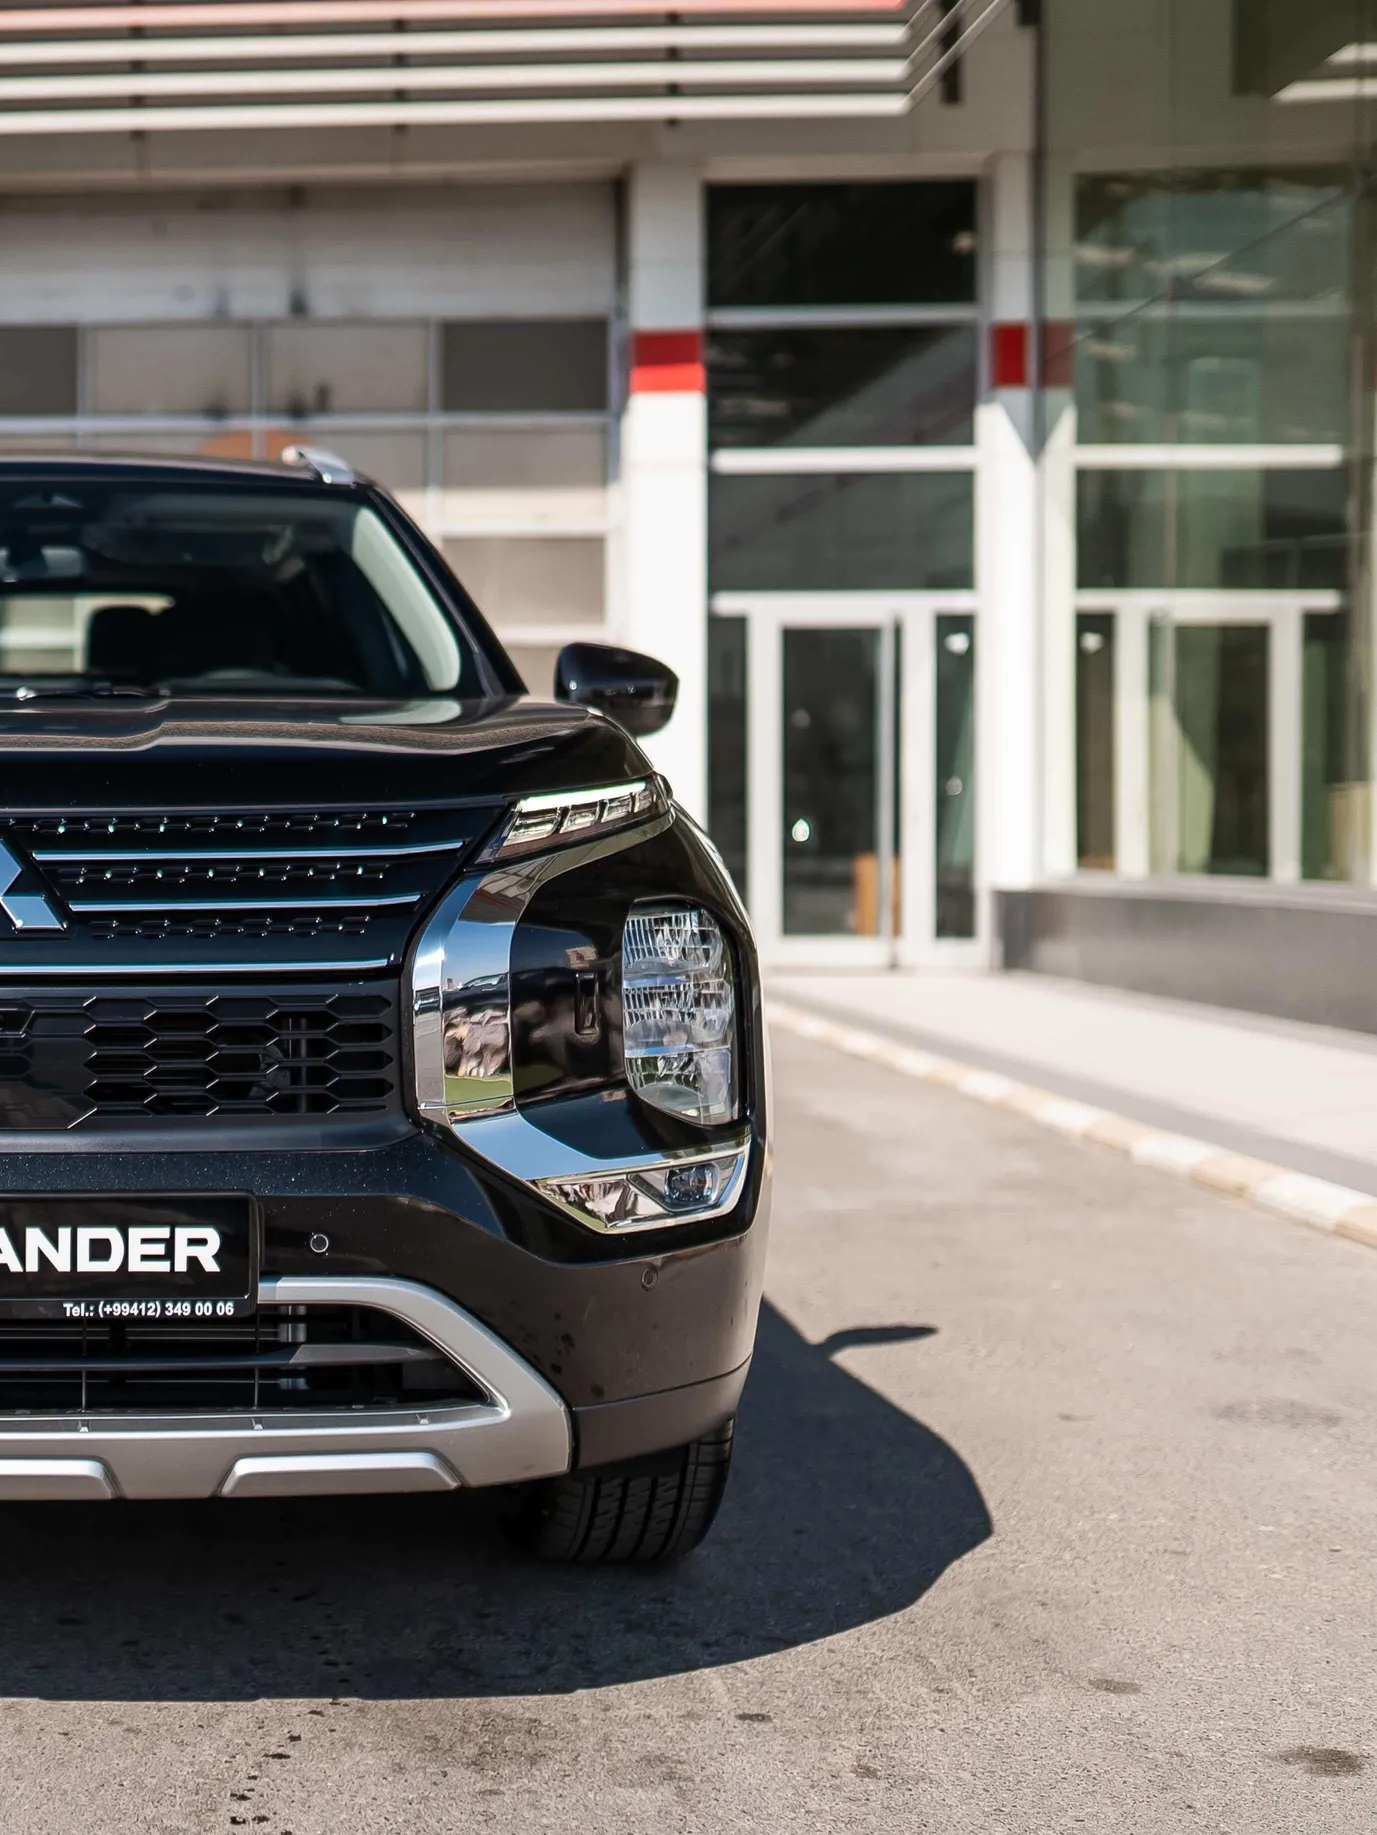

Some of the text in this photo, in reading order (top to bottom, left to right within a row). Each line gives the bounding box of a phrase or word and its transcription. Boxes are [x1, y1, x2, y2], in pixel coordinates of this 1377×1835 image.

[63, 1301, 235, 1318] Tel.: (+99412) 349 00 06
